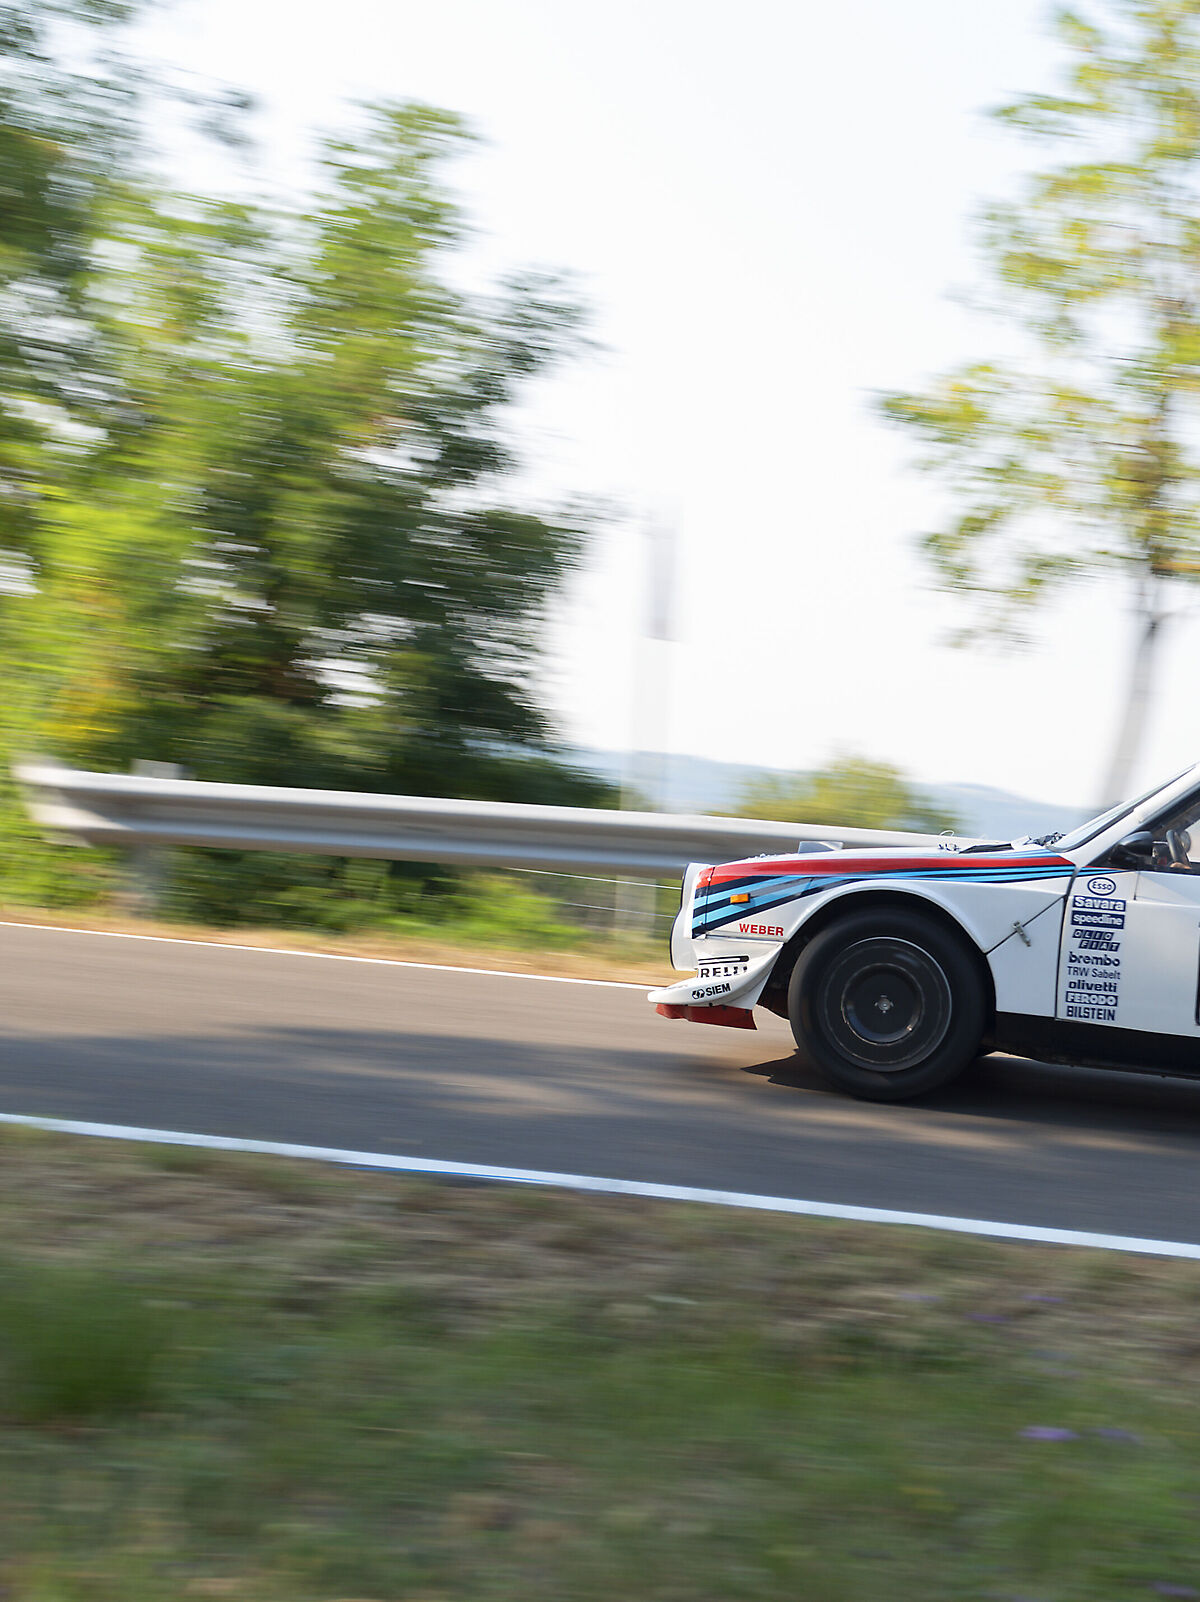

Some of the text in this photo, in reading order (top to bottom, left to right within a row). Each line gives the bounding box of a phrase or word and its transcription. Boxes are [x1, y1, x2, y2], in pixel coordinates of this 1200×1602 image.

[1091, 880, 1113, 892] Esso
[1074, 896, 1125, 911] Savara
[1072, 912, 1123, 927] speedline
[739, 923, 785, 937] WEBER
[1073, 929, 1113, 940] OLIO
[1080, 940, 1119, 951] FIAT
[1068, 951, 1120, 967] brembo
[1067, 966, 1121, 980] TRW Sabelt
[706, 983, 731, 996] SIEM
[1068, 979, 1117, 993] olivetti
[1067, 992, 1117, 1006] FERODO
[1066, 1006, 1116, 1020] BILSTEIN
